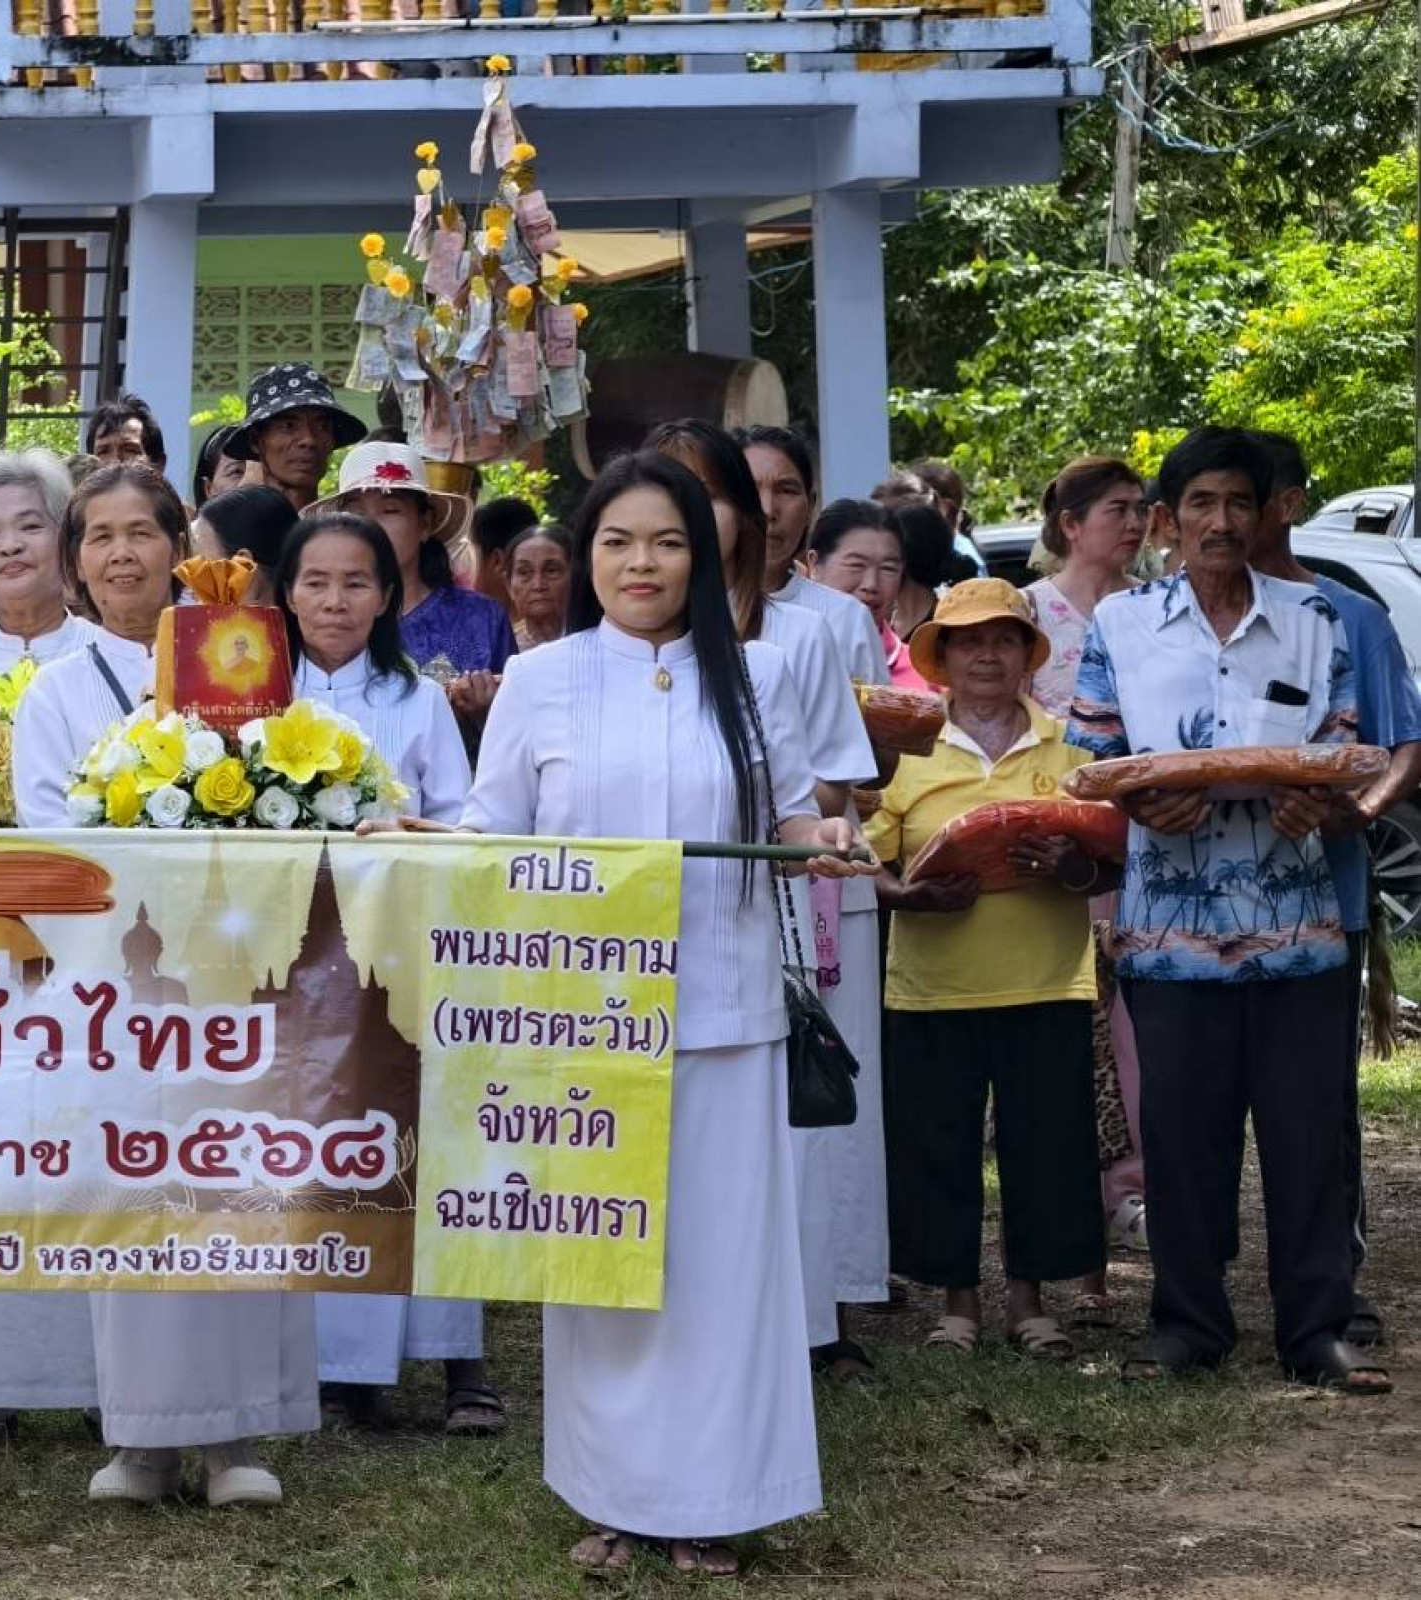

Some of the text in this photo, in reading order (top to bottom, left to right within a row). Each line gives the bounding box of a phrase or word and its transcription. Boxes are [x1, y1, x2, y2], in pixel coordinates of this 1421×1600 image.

[509, 845, 605, 894] ศปธ.
[430, 928, 679, 976] พนมสารคาม
[433, 996, 671, 1060] (เพชรตะวัน)
[478, 1082, 617, 1149] จังหวัด
[99, 1118, 387, 1180] ๒๕๖๘
[435, 1172, 649, 1240] ฉะเชิงเทรา
[39, 1236, 367, 1274] หลวงพ่อธัมมชโย
